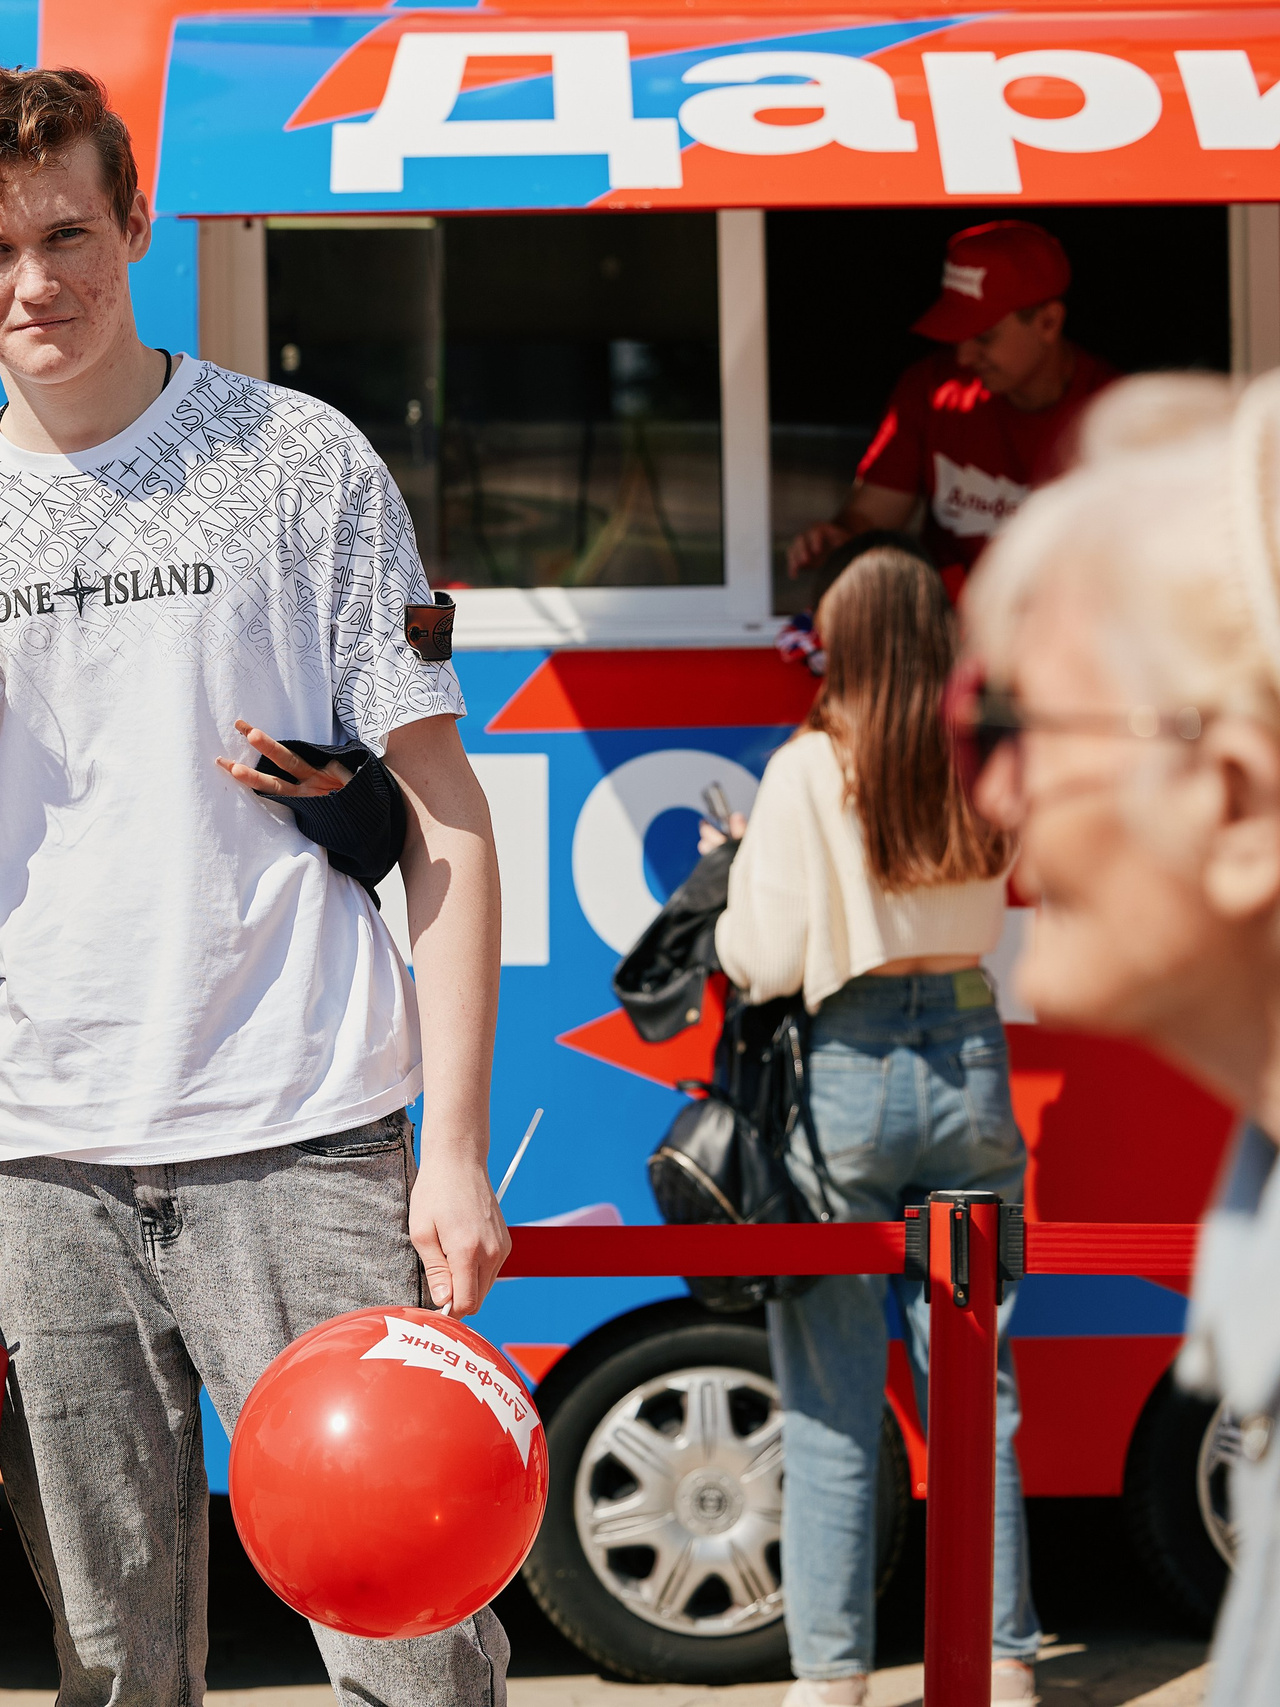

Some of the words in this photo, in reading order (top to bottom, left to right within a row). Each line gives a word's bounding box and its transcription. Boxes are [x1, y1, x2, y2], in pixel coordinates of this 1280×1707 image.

[103, 562, 215, 607] ISLAND
[398, 1333, 461, 1368] Банк
[464, 1360, 527, 1422] Альфа
